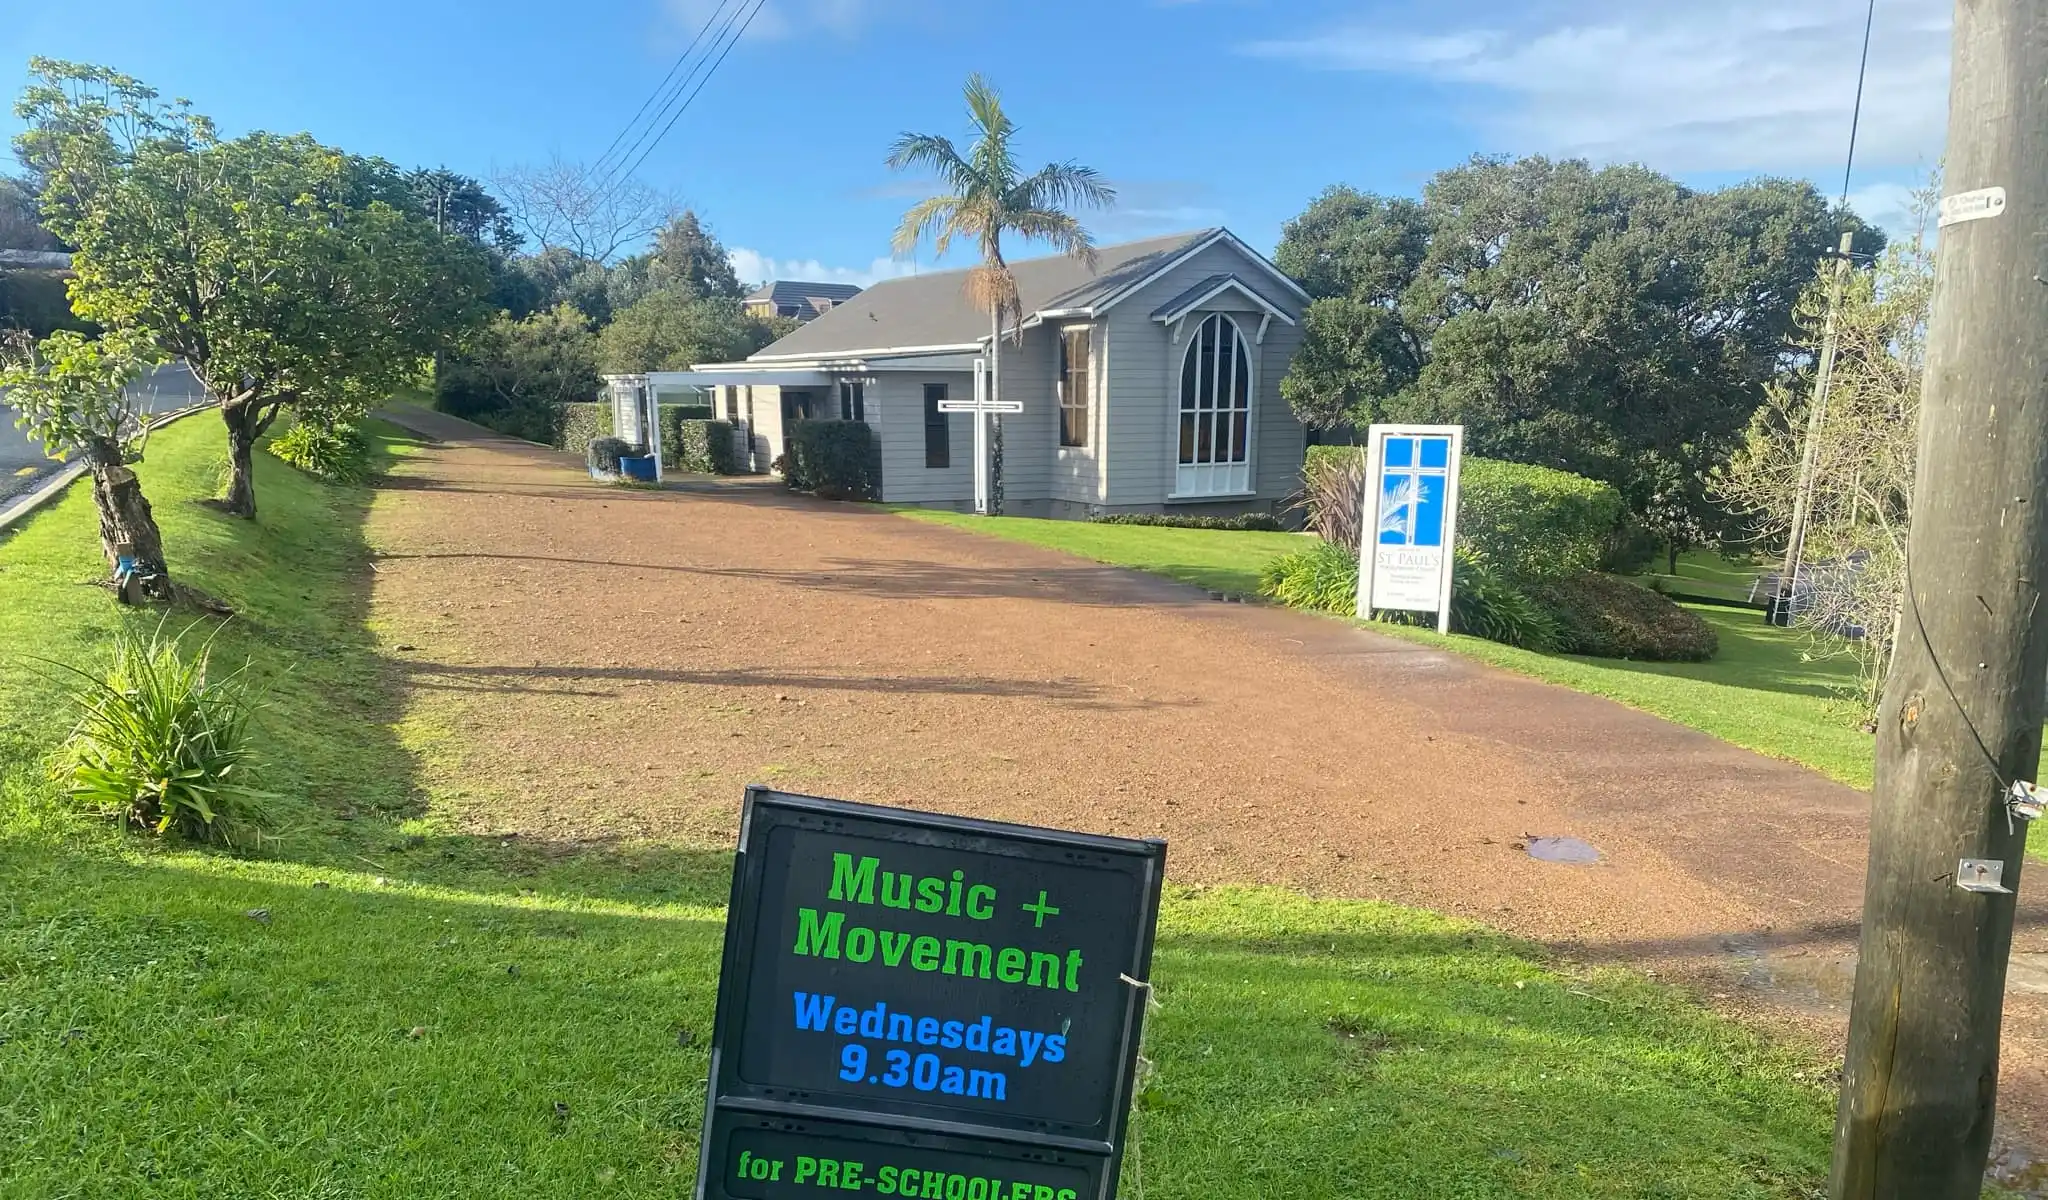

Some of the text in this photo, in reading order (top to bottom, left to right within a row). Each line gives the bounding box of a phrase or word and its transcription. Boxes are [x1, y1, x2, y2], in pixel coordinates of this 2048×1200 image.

[828, 852, 1060, 928] Music +
[793, 907, 1083, 993] Movement
[793, 991, 1067, 1067] Wednesdays
[839, 1044, 1007, 1101] 9.30am
[738, 1150, 783, 1181] for
